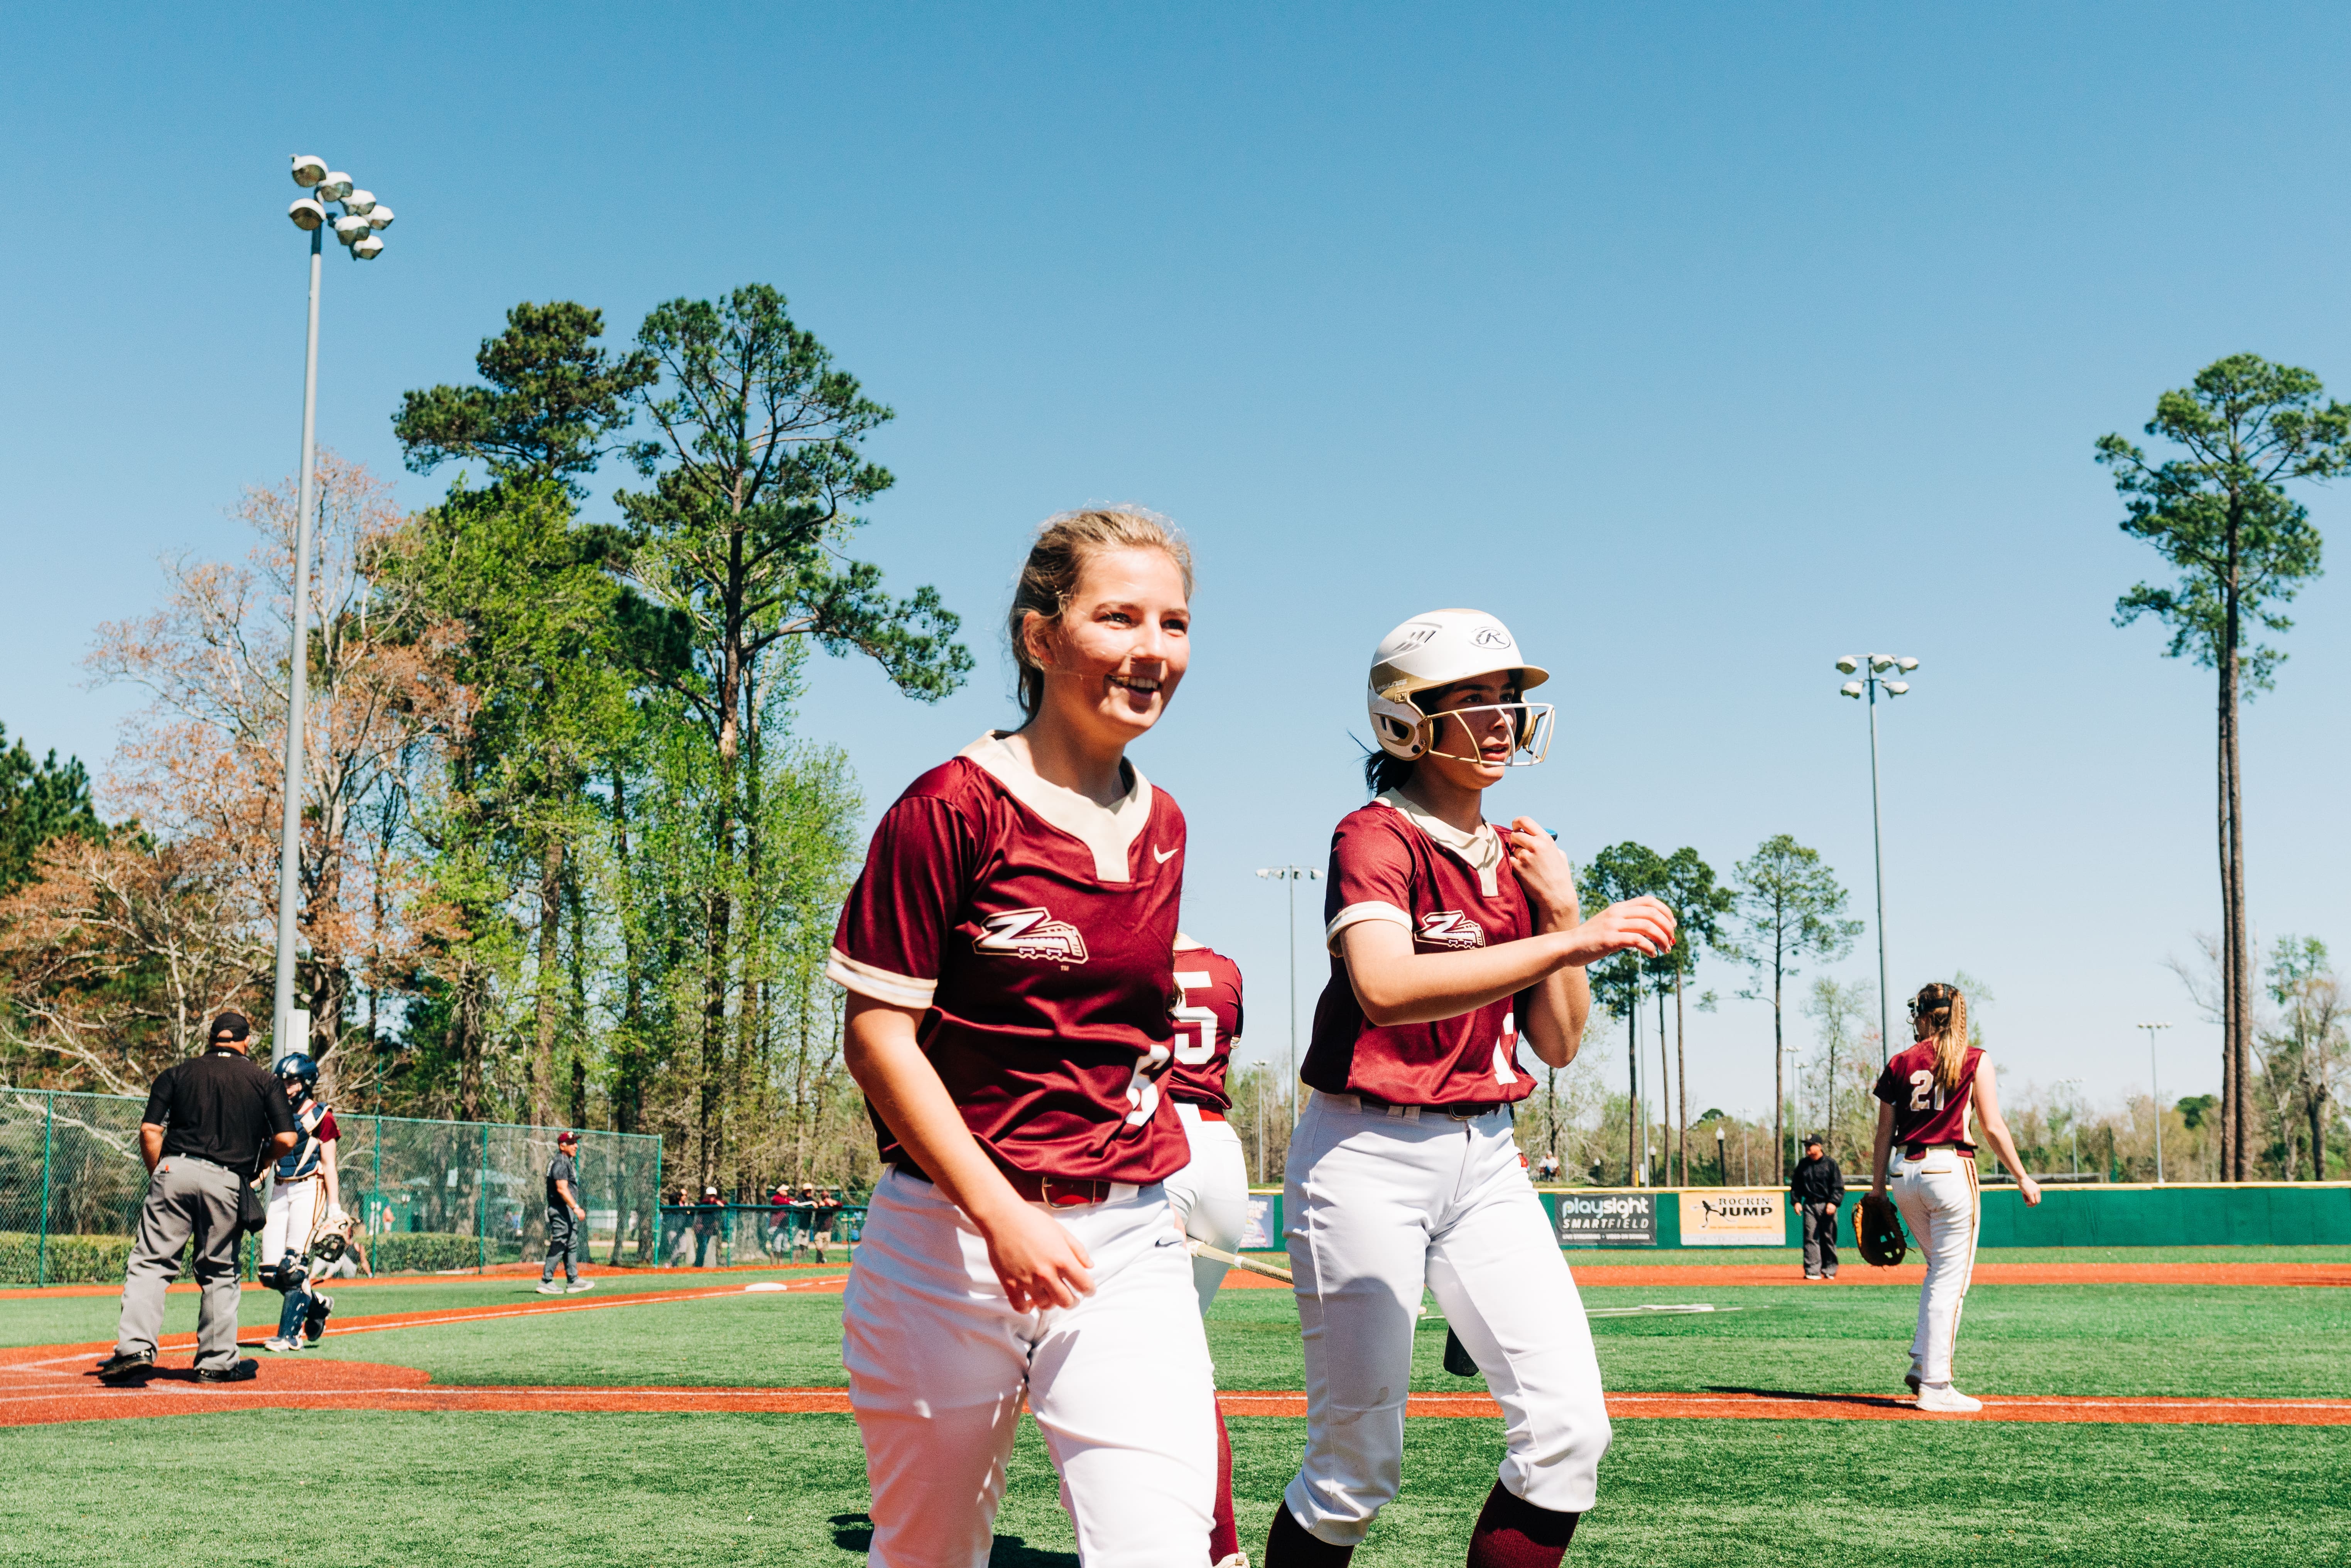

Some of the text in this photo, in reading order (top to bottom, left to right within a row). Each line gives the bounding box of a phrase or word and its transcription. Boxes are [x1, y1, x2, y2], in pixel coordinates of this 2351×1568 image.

[1173, 971, 1218, 1065] 5
[1909, 1070, 1945, 1111] 21
[1562, 1197, 1649, 1219] playsight
[1720, 1207, 1773, 1216] JUMP
[1562, 1218, 1649, 1229] SMARTFIELD
